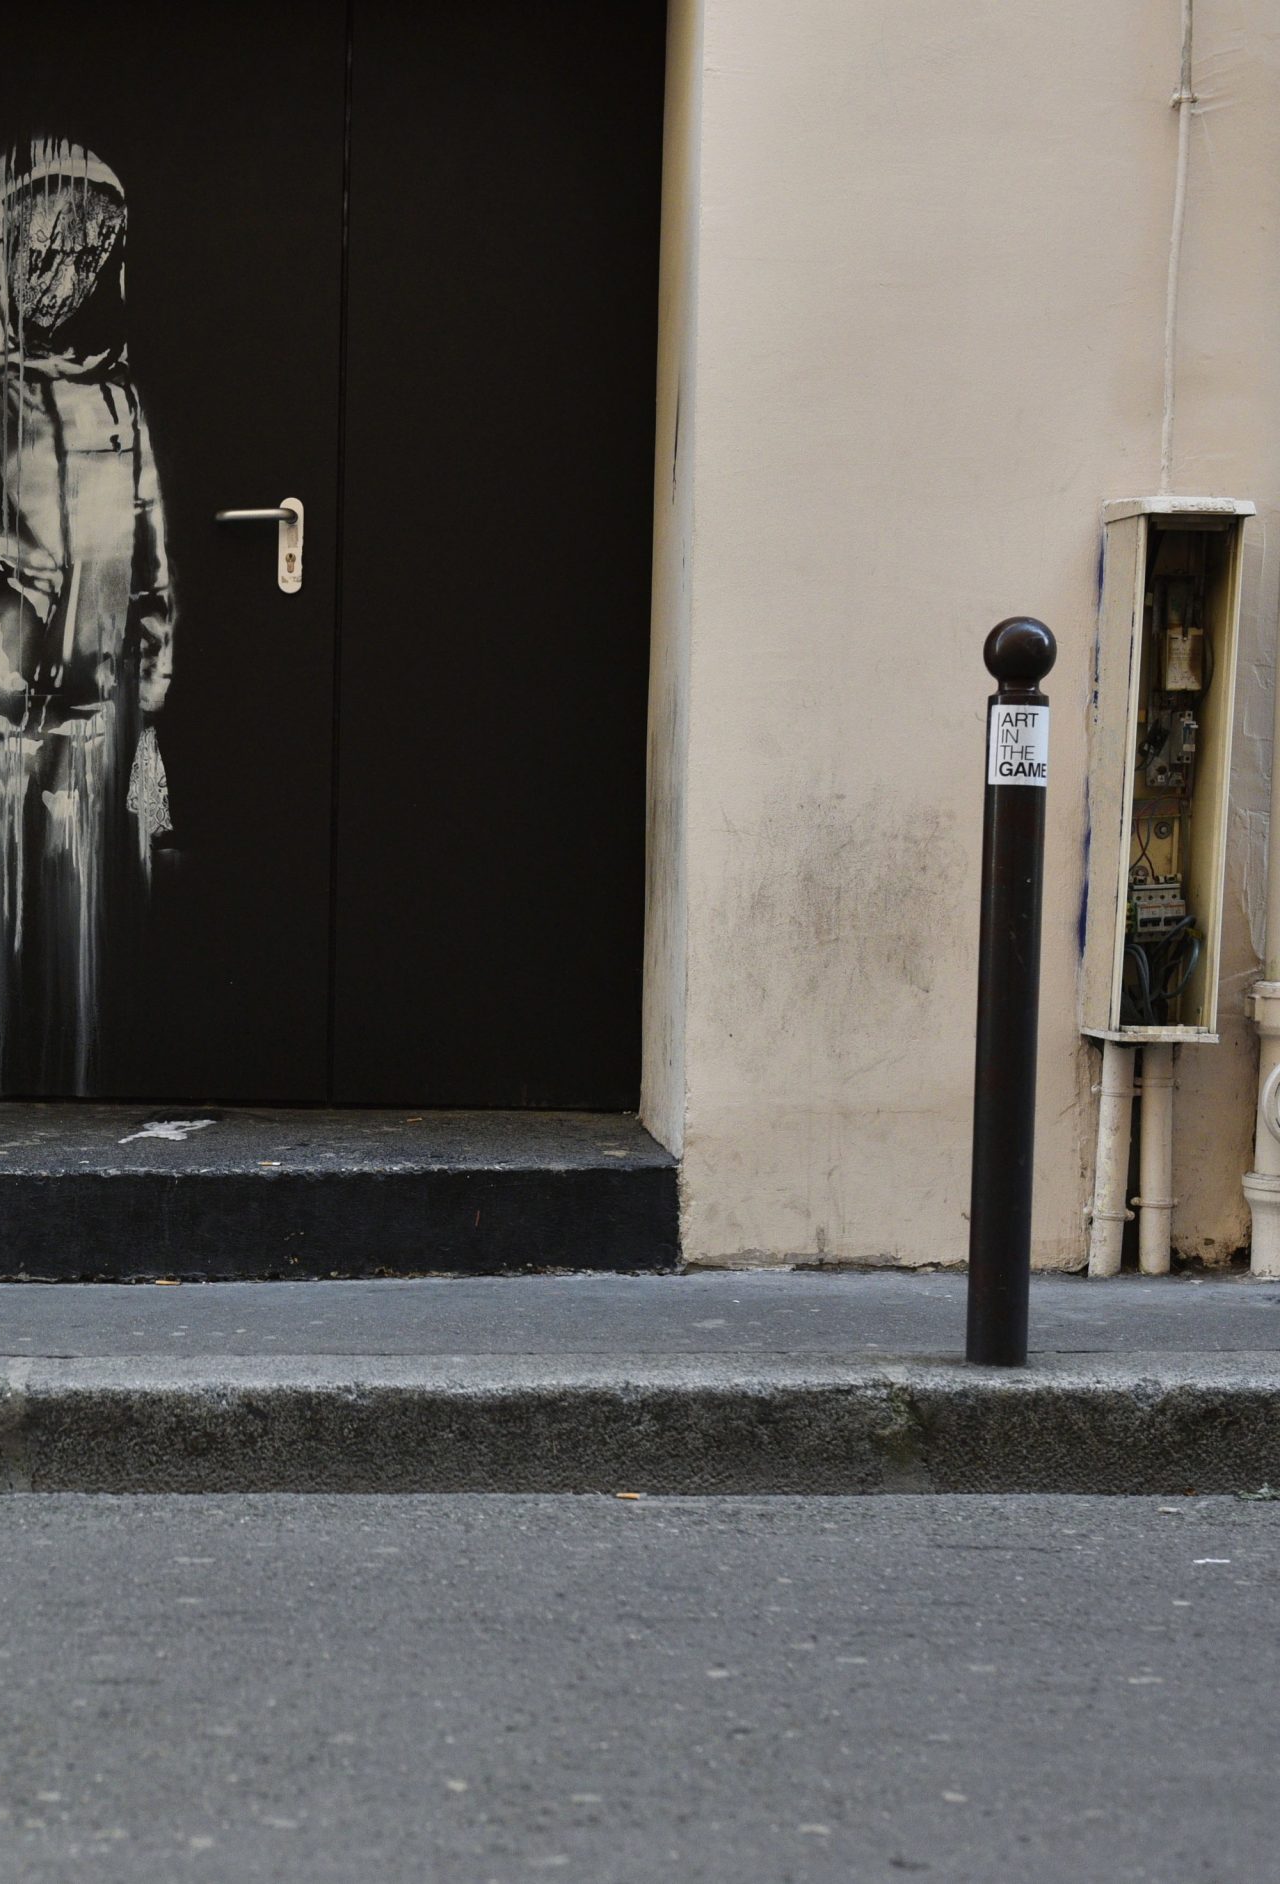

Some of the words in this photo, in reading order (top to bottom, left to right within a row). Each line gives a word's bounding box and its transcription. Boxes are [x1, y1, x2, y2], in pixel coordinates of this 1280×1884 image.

[1001, 712, 1039, 728] ART
[1001, 728, 1019, 743] IN
[1000, 745, 1035, 760] THE
[999, 761, 1047, 778] GAME
